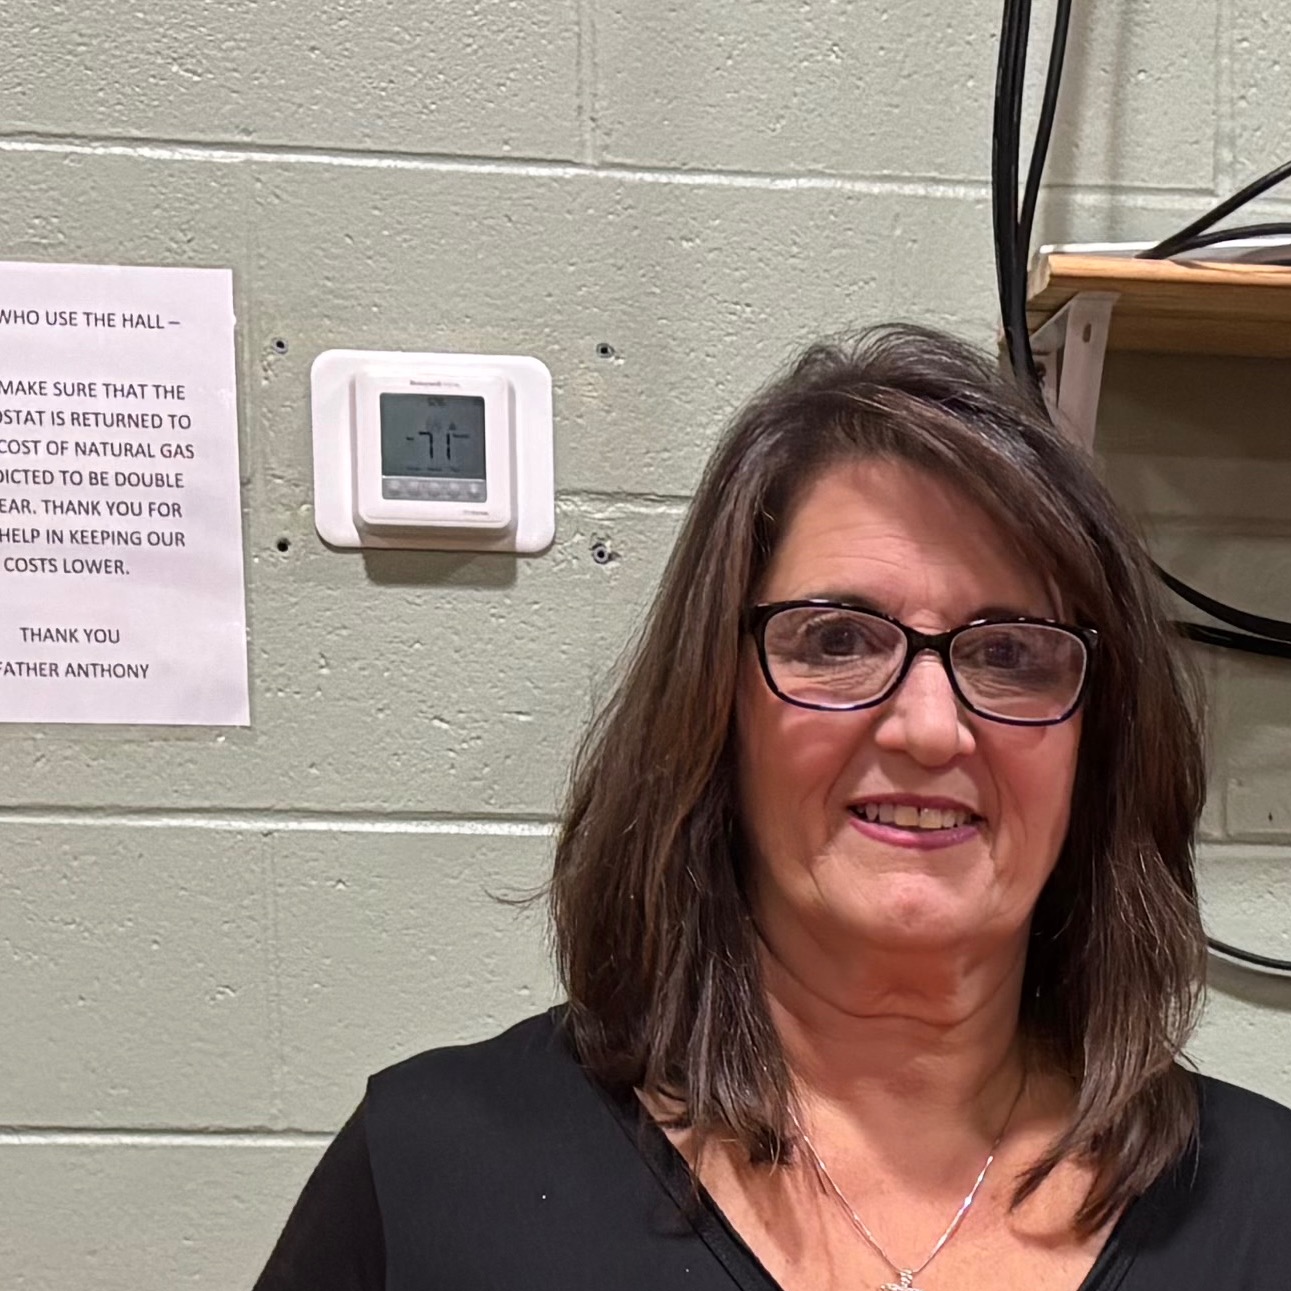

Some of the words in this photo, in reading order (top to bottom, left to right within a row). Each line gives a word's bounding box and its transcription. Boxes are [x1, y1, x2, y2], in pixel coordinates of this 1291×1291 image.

[0, 309, 39, 325] WHO
[45, 311, 78, 326] USE
[83, 312, 116, 328] THE
[122, 313, 165, 329] HALL
[0, 380, 48, 396] MAKE
[53, 381, 97, 398] SURE
[102, 383, 148, 399] THAT
[152, 384, 186, 400] THE
[0, 410, 46, 426] STAT
[51, 411, 65, 426] IS
[70, 411, 163, 429] RETURNED
[167, 415, 192, 430] TO
[0, 439, 41, 455] COST
[46, 440, 69, 456] OF
[75, 441, 156, 458] NATURAL
[160, 443, 195, 459] GAS
[59, 470, 83, 486] TO
[89, 471, 110, 487] BE
[114, 472, 185, 488] DOUBLE
[0, 499, 37, 515] EAR.
[41, 500, 101, 516] THANK
[106, 501, 142, 517] YOU
[149, 502, 183, 518] FOR
[0, 528, 40, 544] HELP
[46, 529, 63, 545] IN
[69, 530, 142, 546] KEEPING
[147, 531, 186, 547] OUR
[3, 557, 58, 573] COSTS
[63, 558, 130, 575] LOWER.
[19, 627, 79, 643] THANK
[83, 628, 120, 644] YOU
[64, 663, 150, 679] ANTHONY
